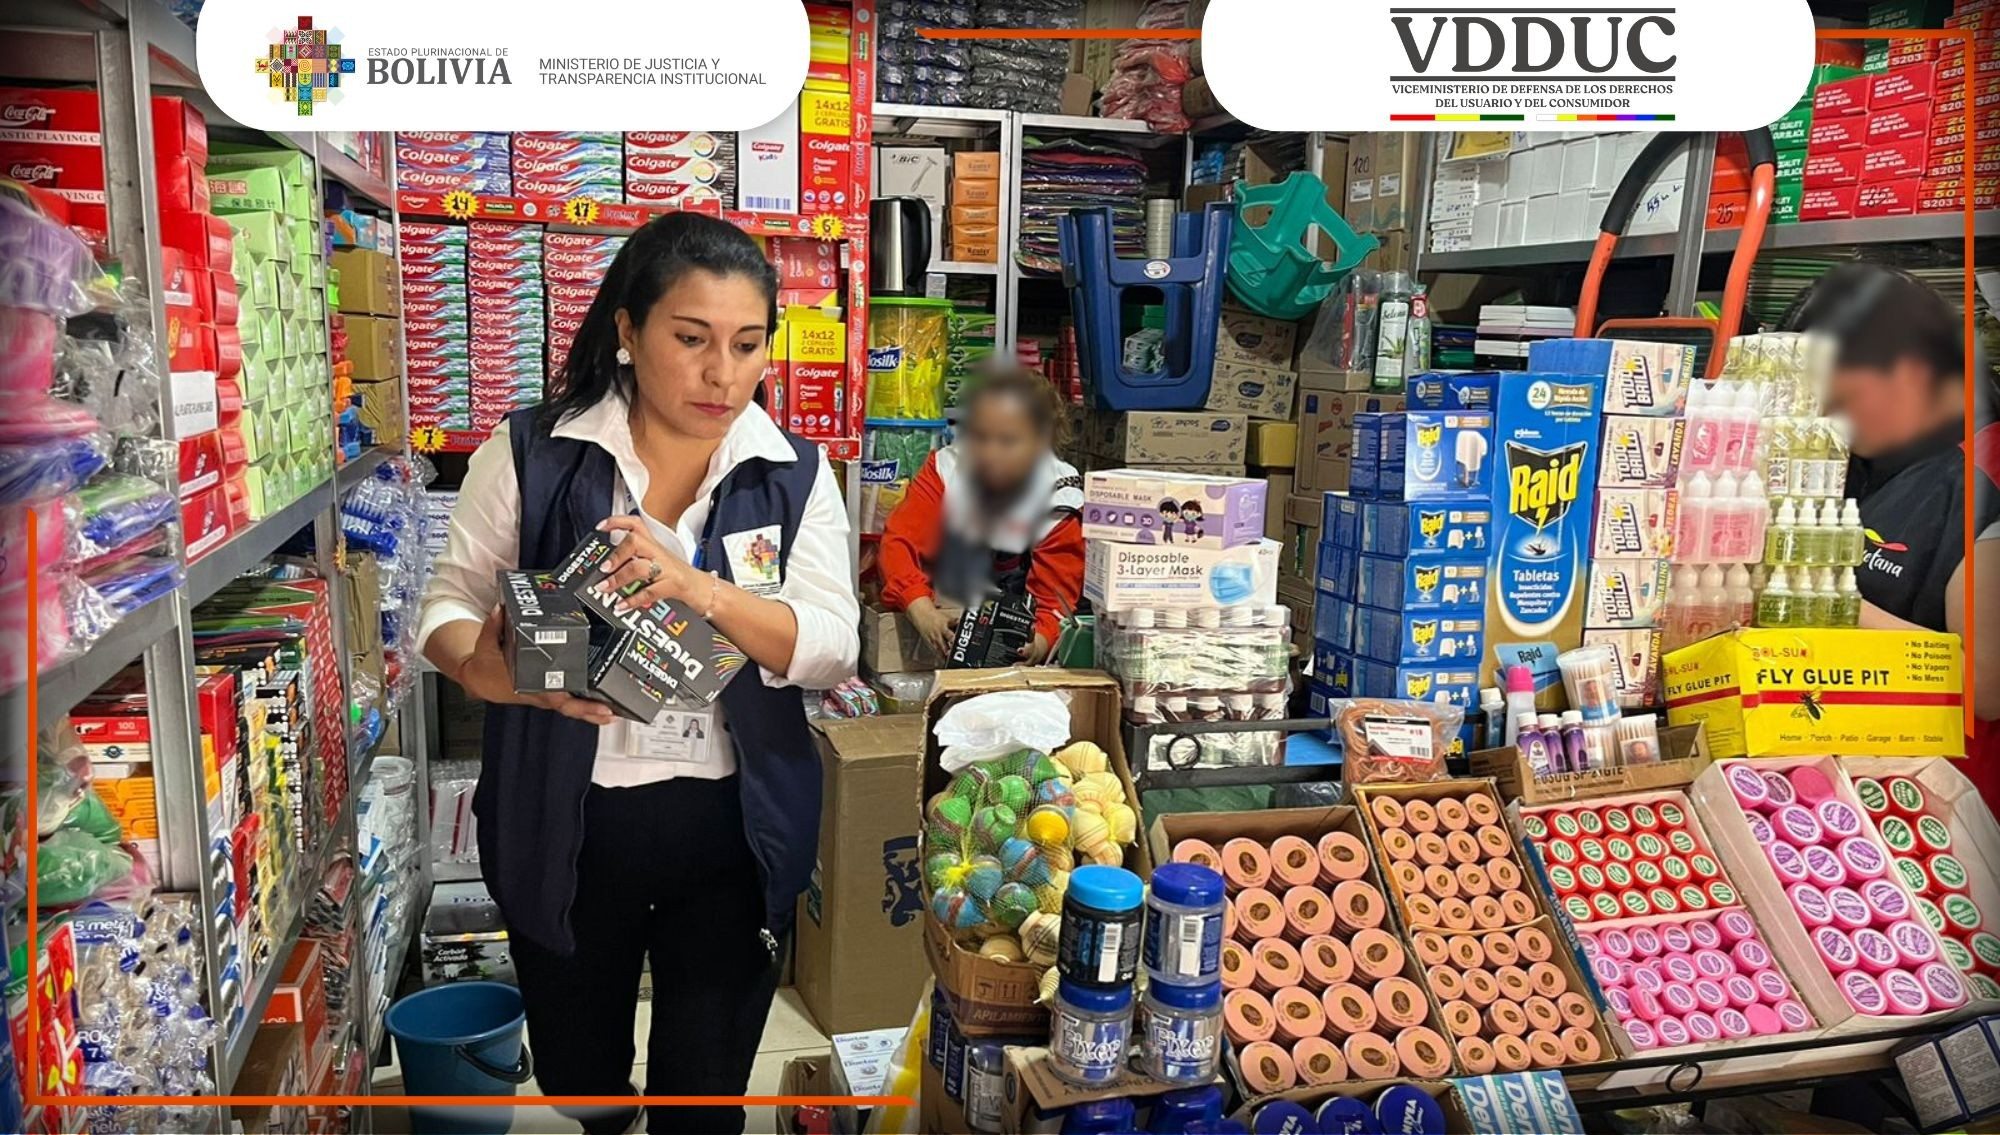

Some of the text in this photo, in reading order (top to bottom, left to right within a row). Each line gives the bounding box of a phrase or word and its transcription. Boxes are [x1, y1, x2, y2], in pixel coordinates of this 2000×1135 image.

[1891, 54, 1922, 65] S203
[815, 100, 850, 110] 14x12
[815, 118, 850, 128] GRATIS
[36, 132, 87, 142] PLAYING
[628, 131, 679, 142] Colgate
[1936, 134, 1965, 145] S203
[515, 137, 569, 151] Colgate
[399, 148, 460, 164] Colgate
[515, 158, 569, 173] Colgate
[629, 157, 679, 169] Colgate
[1352, 155, 1370, 175] 120
[1932, 165, 1962, 175] S203
[400, 169, 461, 185] Colgate
[628, 183, 679, 194] Colgate
[452, 196, 468, 211] 14
[575, 203, 589, 217] 17
[1922, 199, 1953, 208] S203
[400, 225, 438, 235] olgate
[470, 221, 514, 234] Colgate
[470, 240, 514, 252] Colgate
[546, 234, 594, 247] Colgate
[400, 245, 436, 255] olgate
[547, 251, 594, 265] Colgate
[471, 260, 514, 271] Colgate
[547, 268, 595, 281] Colgate
[471, 279, 515, 290] Colgate
[472, 296, 510, 305] Colgate
[801, 330, 835, 340] 14x12
[801, 346, 836, 356] GRATIS
[795, 367, 839, 378] Colgate
[1532, 387, 1546, 399] 24
[1671, 421, 1685, 465] LAVANDA
[1510, 453, 1580, 514] Raid
[1090, 490, 1152, 501] DISPOSABLE MASK
[1421, 516, 1444, 534] Raid
[560, 540, 600, 583] DIGESTAN
[1118, 551, 1190, 565] Disposable
[1861, 547, 1903, 577] etana
[1116, 564, 1203, 577] 3-Layer Mask
[1513, 569, 1560, 581] Tabletas
[1416, 571, 1439, 589] Raid
[1658, 561, 1669, 600] MARINO
[1413, 626, 1436, 644] Raid
[1517, 647, 1543, 663] Raid
[1648, 632, 1662, 674] LAVANDA
[627, 649, 679, 689] DIGESTAN
[1757, 669, 1890, 686] FLY GLUE PIT
[1408, 679, 1431, 697] Raid
[1667, 673, 1732, 696] FLY GLUE PIT
[1840, 734, 1859, 742] Patio
[1401, 1099, 1418, 1135] NIVEA
